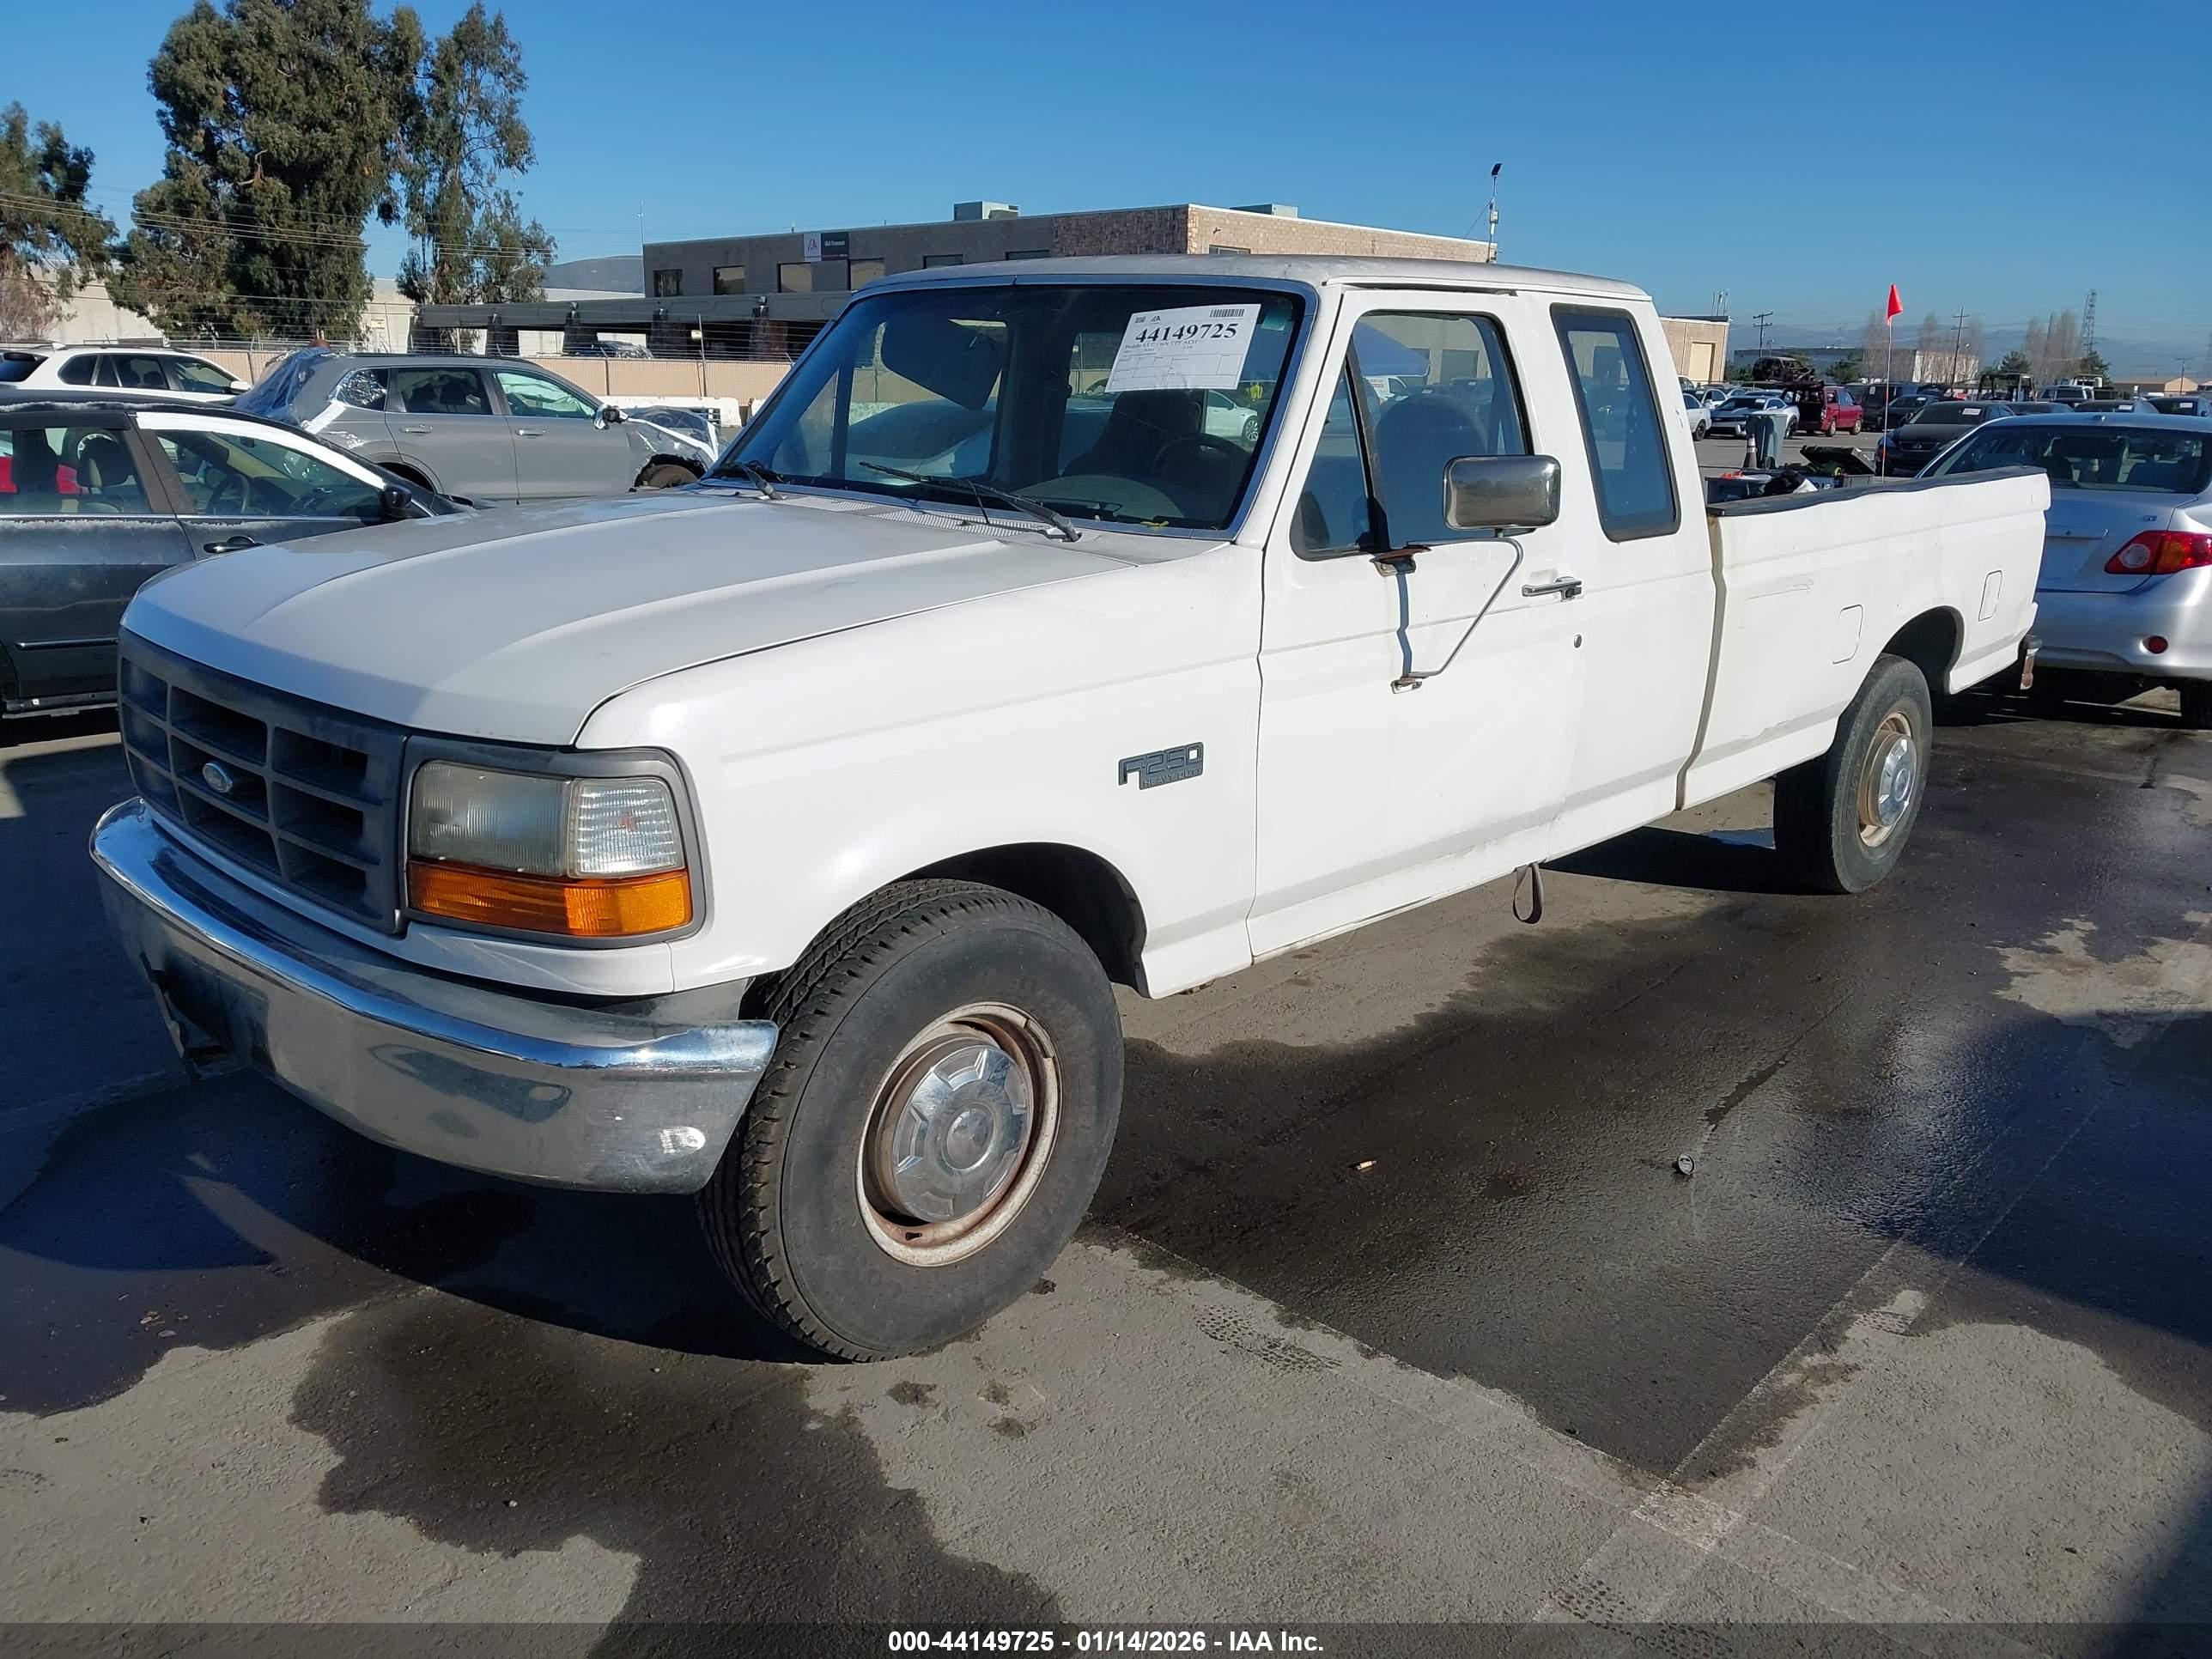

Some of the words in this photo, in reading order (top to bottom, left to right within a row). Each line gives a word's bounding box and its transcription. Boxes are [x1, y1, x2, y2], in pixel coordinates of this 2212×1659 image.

[1135, 323, 1238, 343] 44149725
[1142, 773, 1176, 788] HEAVY
[1176, 767, 1201, 781] DUTY
